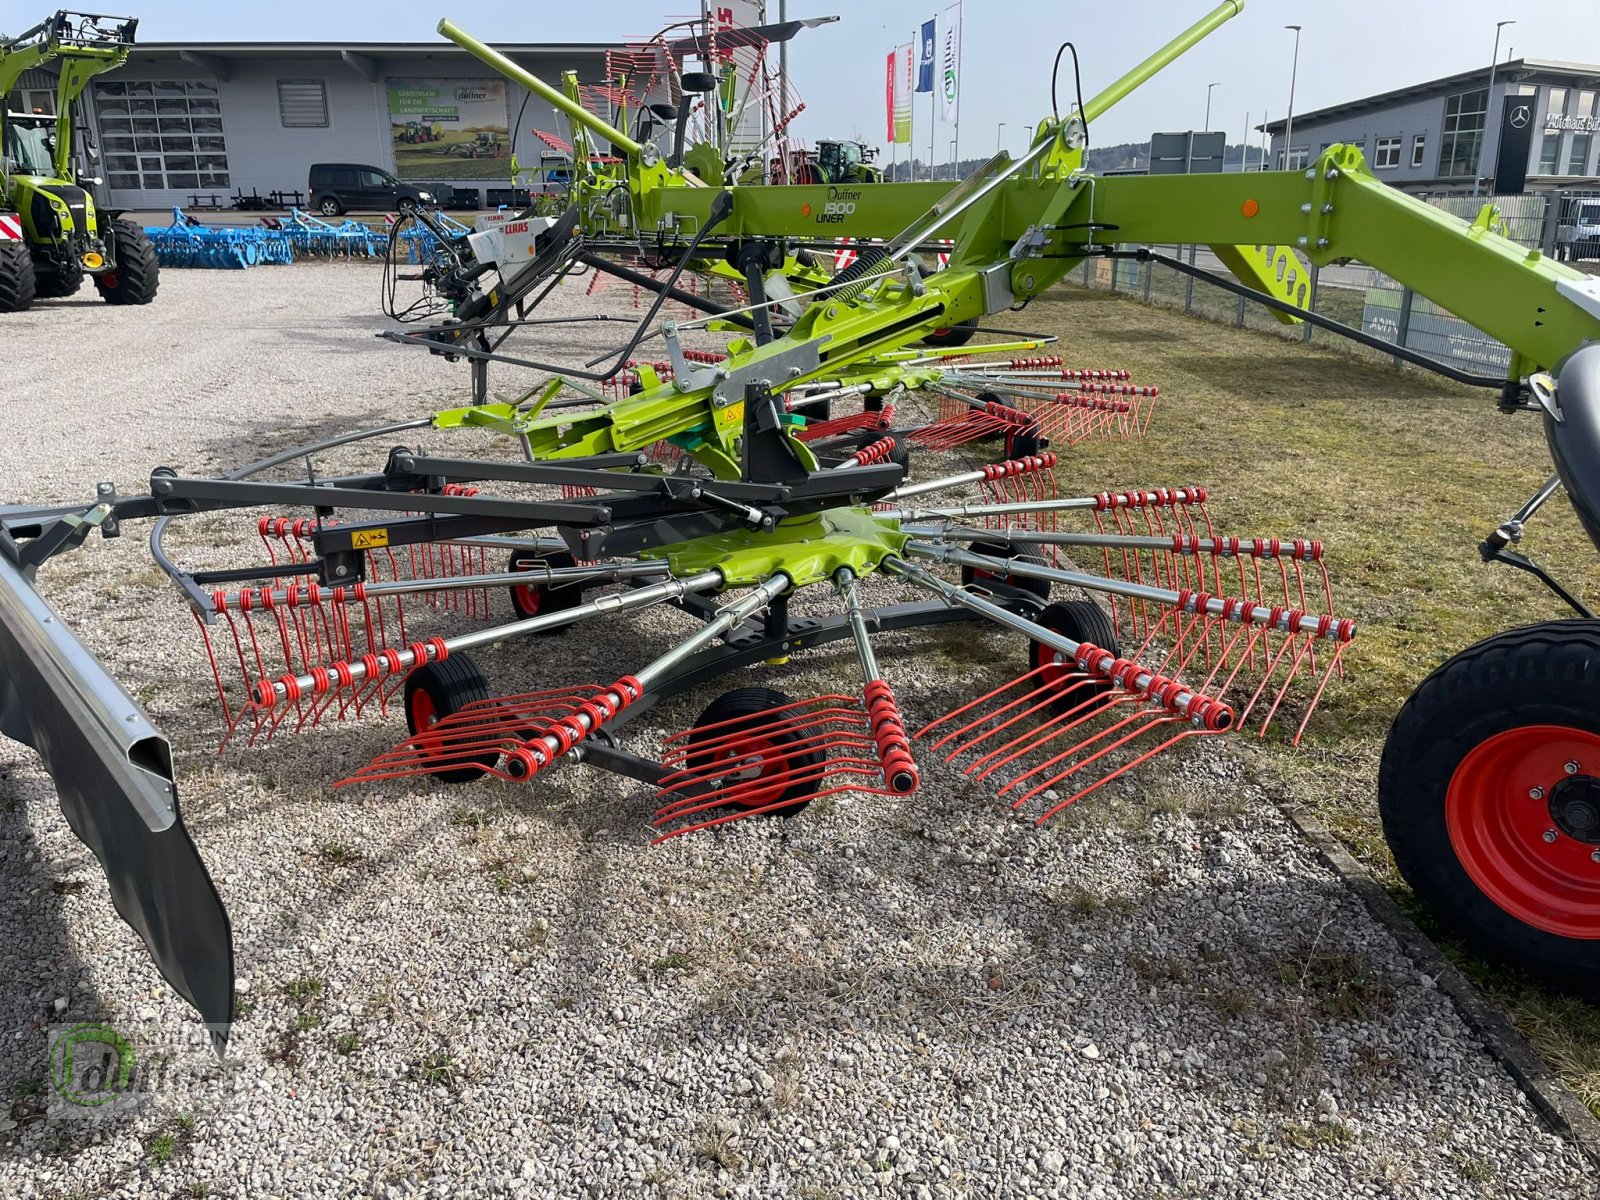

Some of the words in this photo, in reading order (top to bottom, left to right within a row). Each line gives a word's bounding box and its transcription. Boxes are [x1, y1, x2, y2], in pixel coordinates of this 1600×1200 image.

[1548, 114, 1585, 130] Autohaus
[827, 186, 861, 202] Duffner
[825, 202, 855, 214] 1900
[816, 213, 844, 223] LINER
[505, 222, 529, 235] CLAAS
